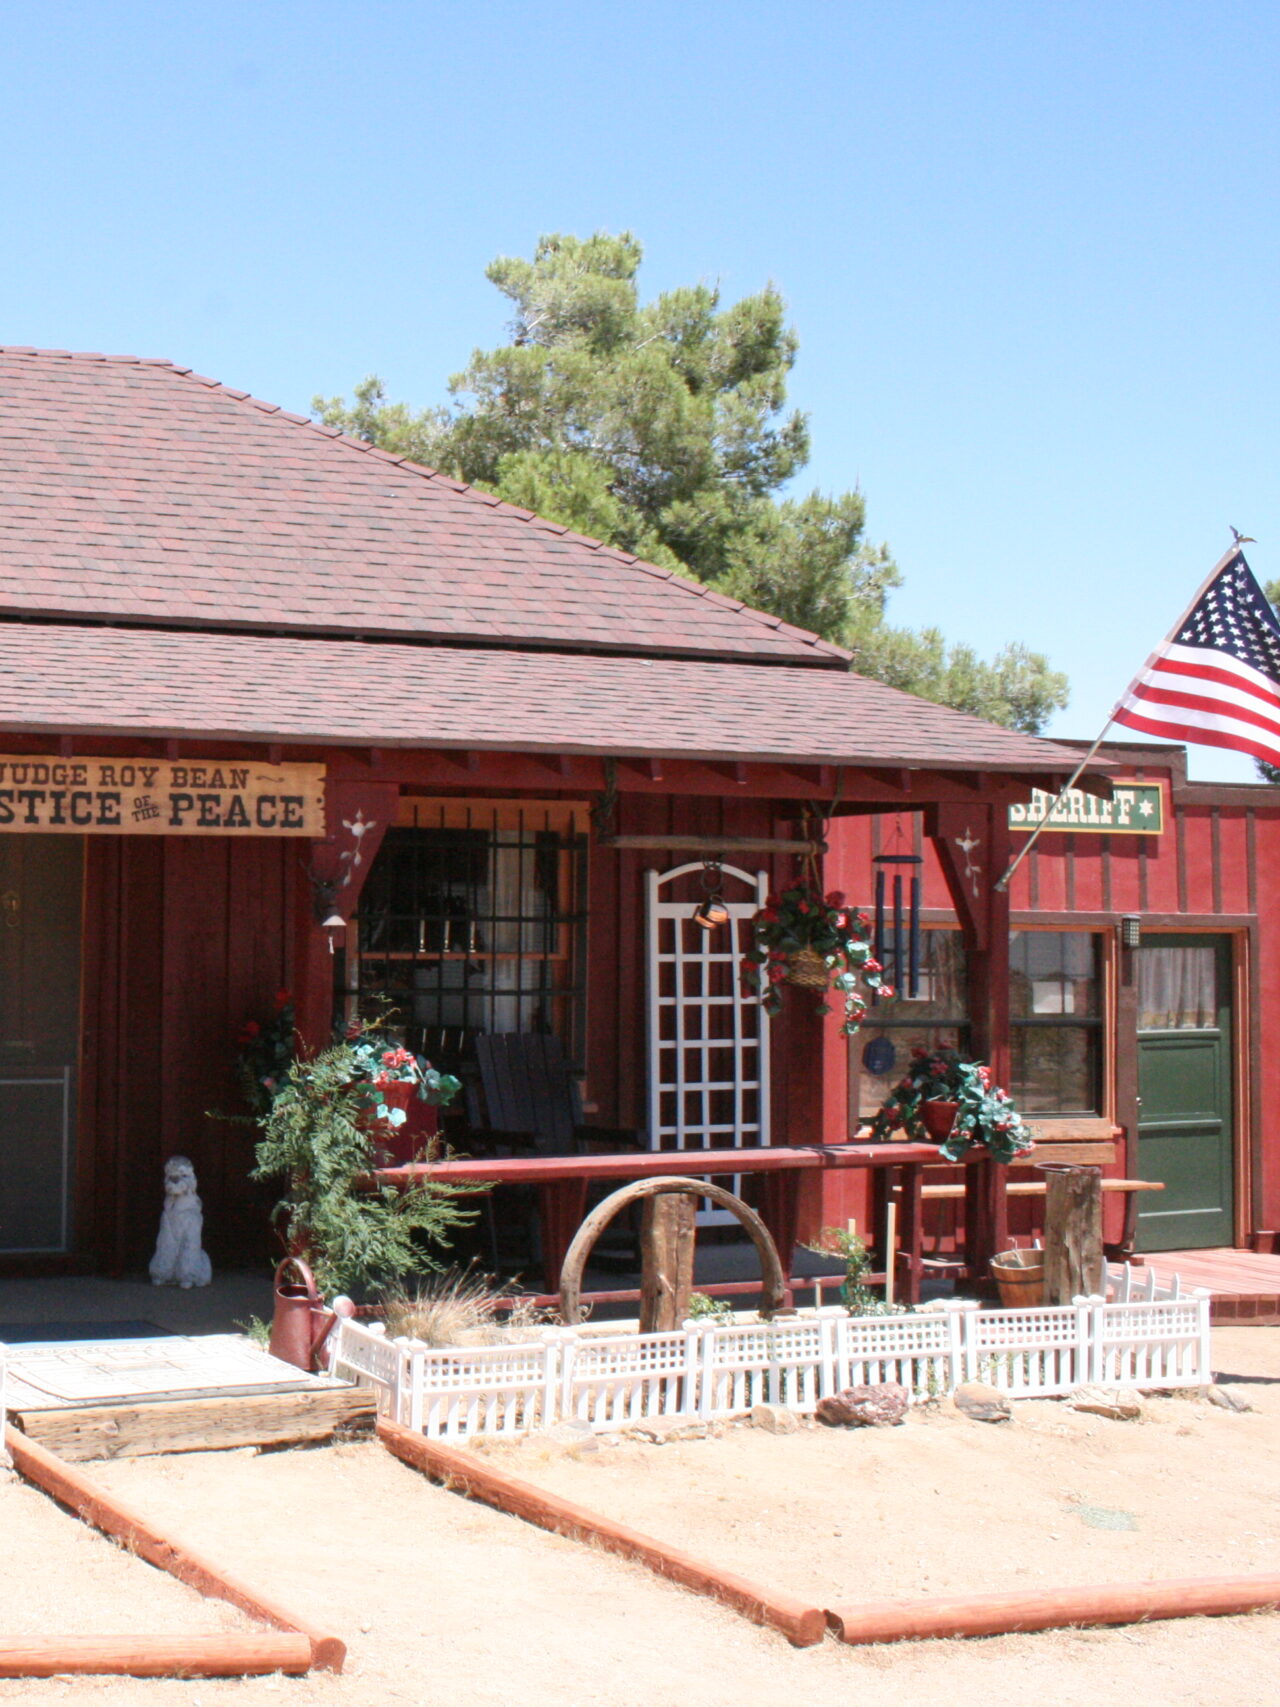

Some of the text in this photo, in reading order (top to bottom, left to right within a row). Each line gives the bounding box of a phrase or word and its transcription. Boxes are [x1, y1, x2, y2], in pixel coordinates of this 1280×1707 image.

[98, 765, 159, 788] ROY
[170, 767, 250, 789] BEAN
[133, 795, 151, 809] OF
[168, 793, 304, 828] PEACE
[131, 806, 160, 822] THE
